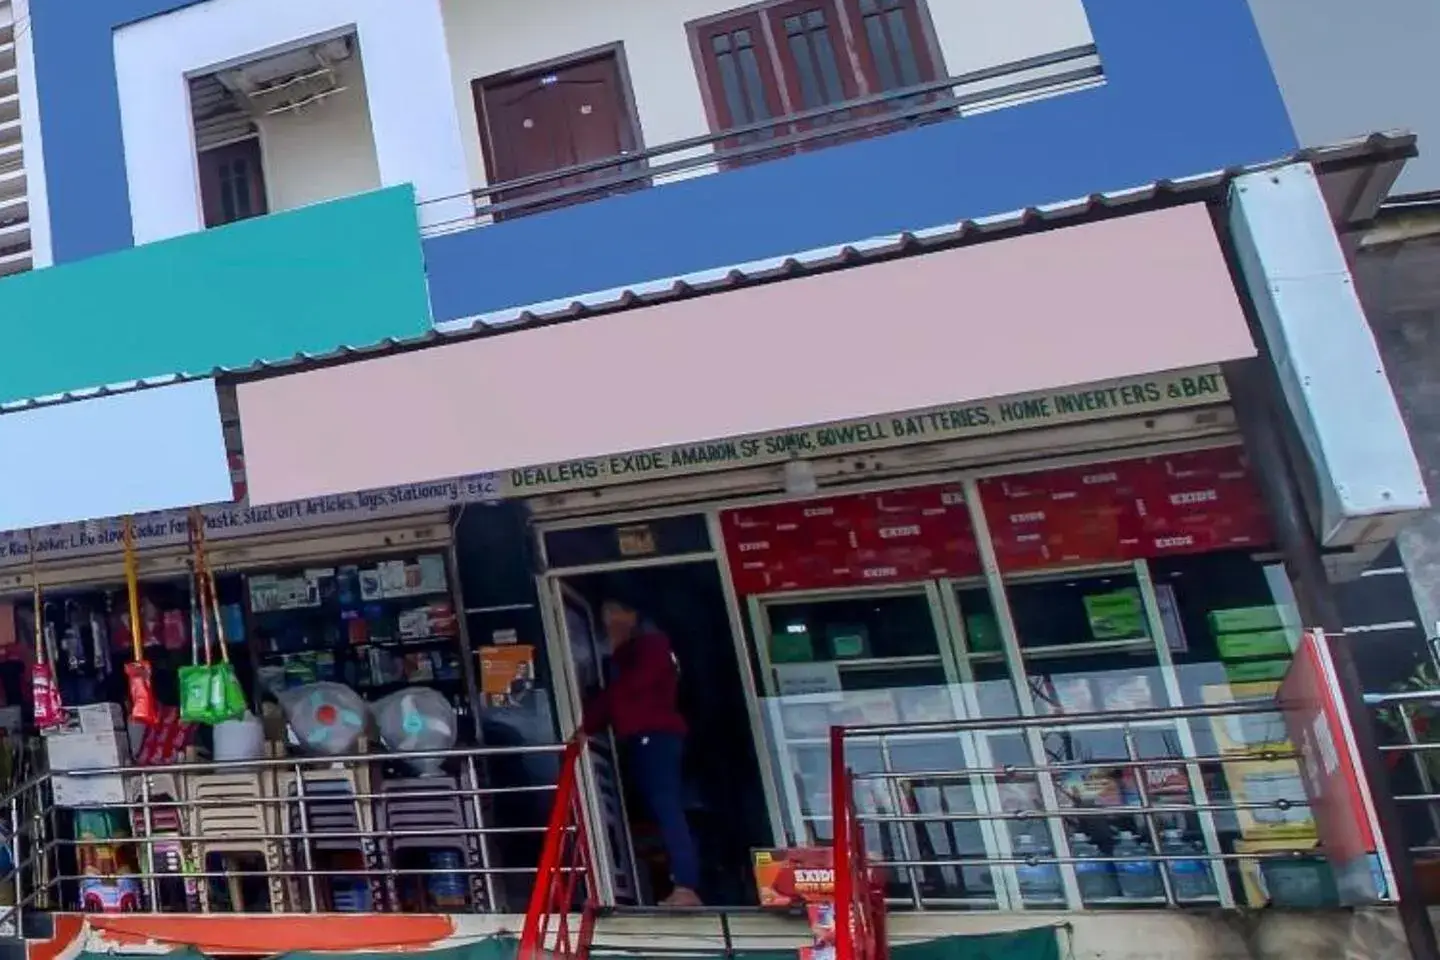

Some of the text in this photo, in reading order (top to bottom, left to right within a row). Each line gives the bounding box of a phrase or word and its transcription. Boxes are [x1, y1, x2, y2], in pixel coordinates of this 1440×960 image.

[740, 440, 759, 458] SF
[999, 397, 1051, 422] HOME
[1053, 381, 1160, 414] INVERTERS
